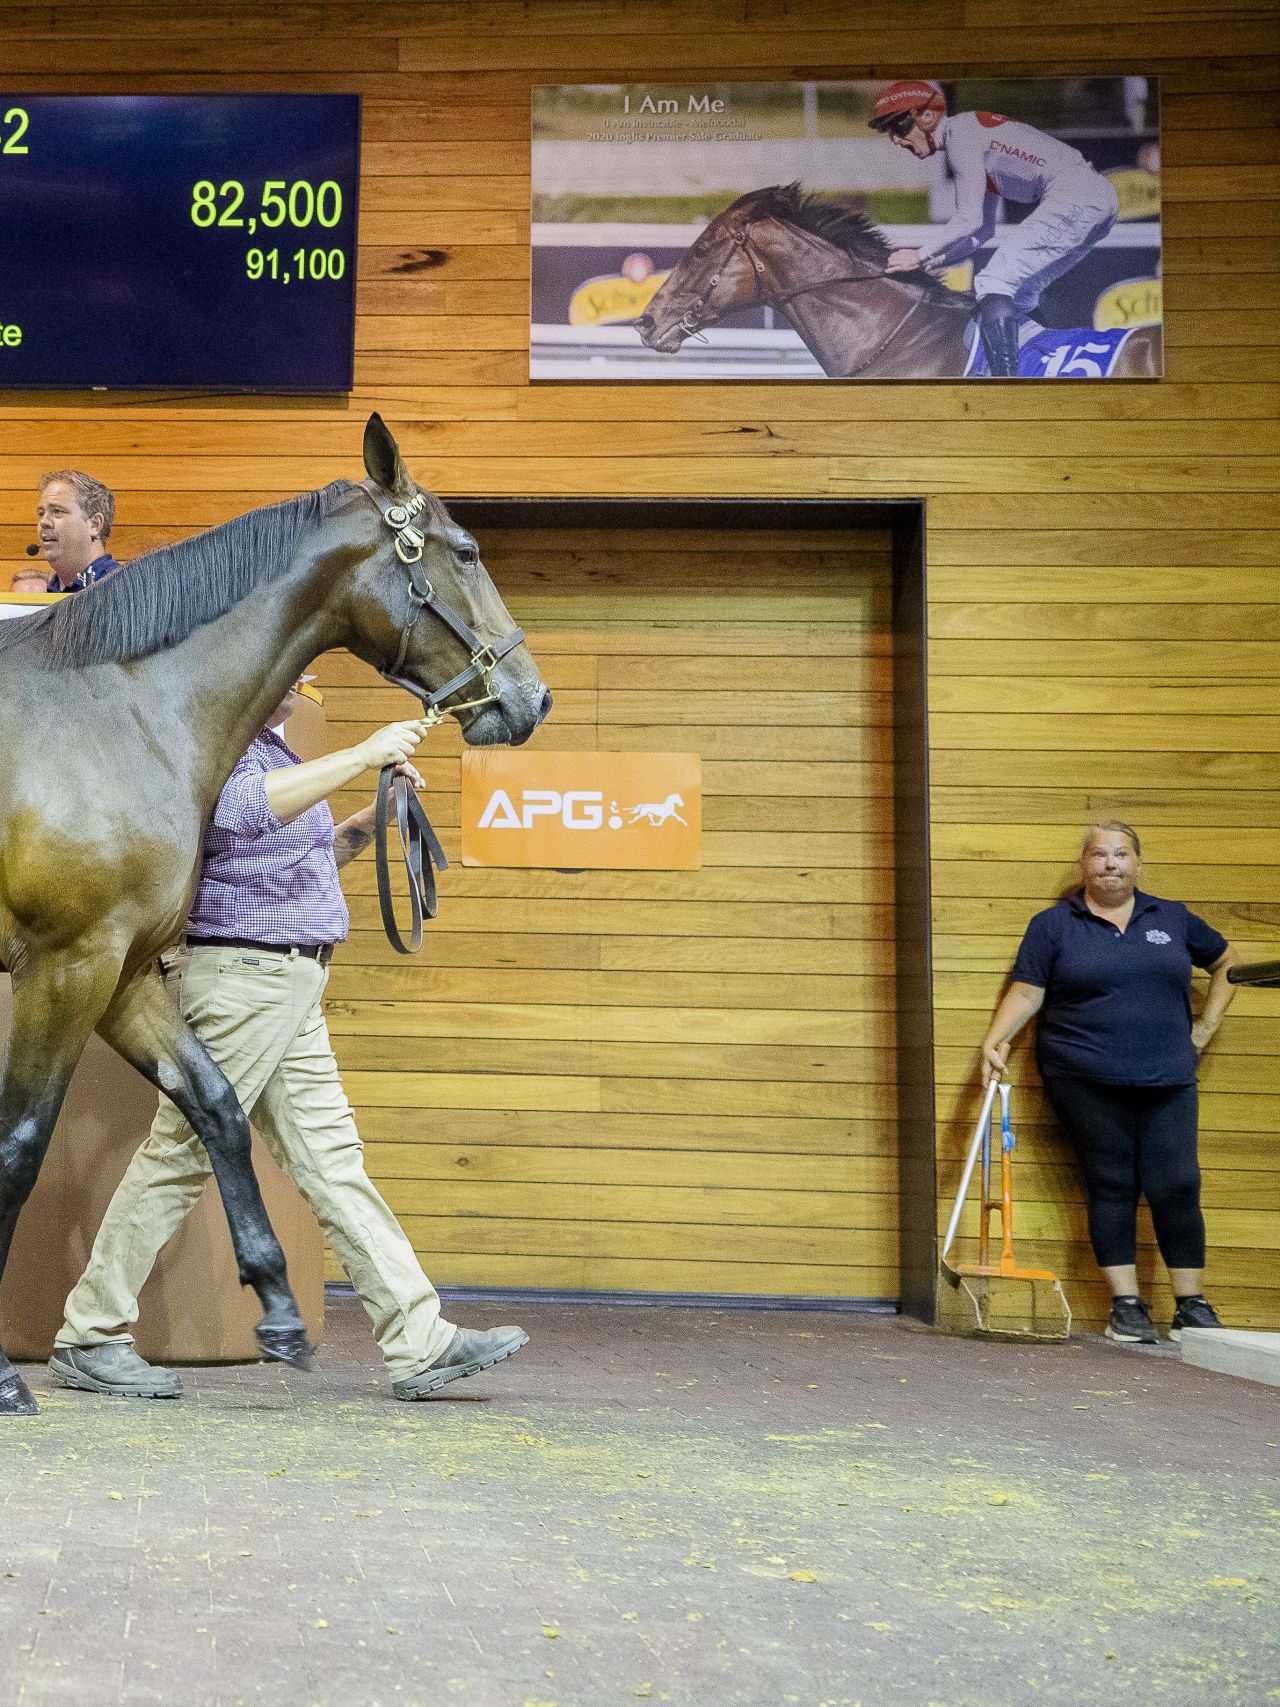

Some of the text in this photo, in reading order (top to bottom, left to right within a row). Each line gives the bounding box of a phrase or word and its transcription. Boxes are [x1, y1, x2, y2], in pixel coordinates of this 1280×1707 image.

[624, 95, 725, 114] I Am Me
[190, 180, 343, 235] 82,500
[246, 248, 345, 284] 91,100
[476, 789, 604, 830] APG
